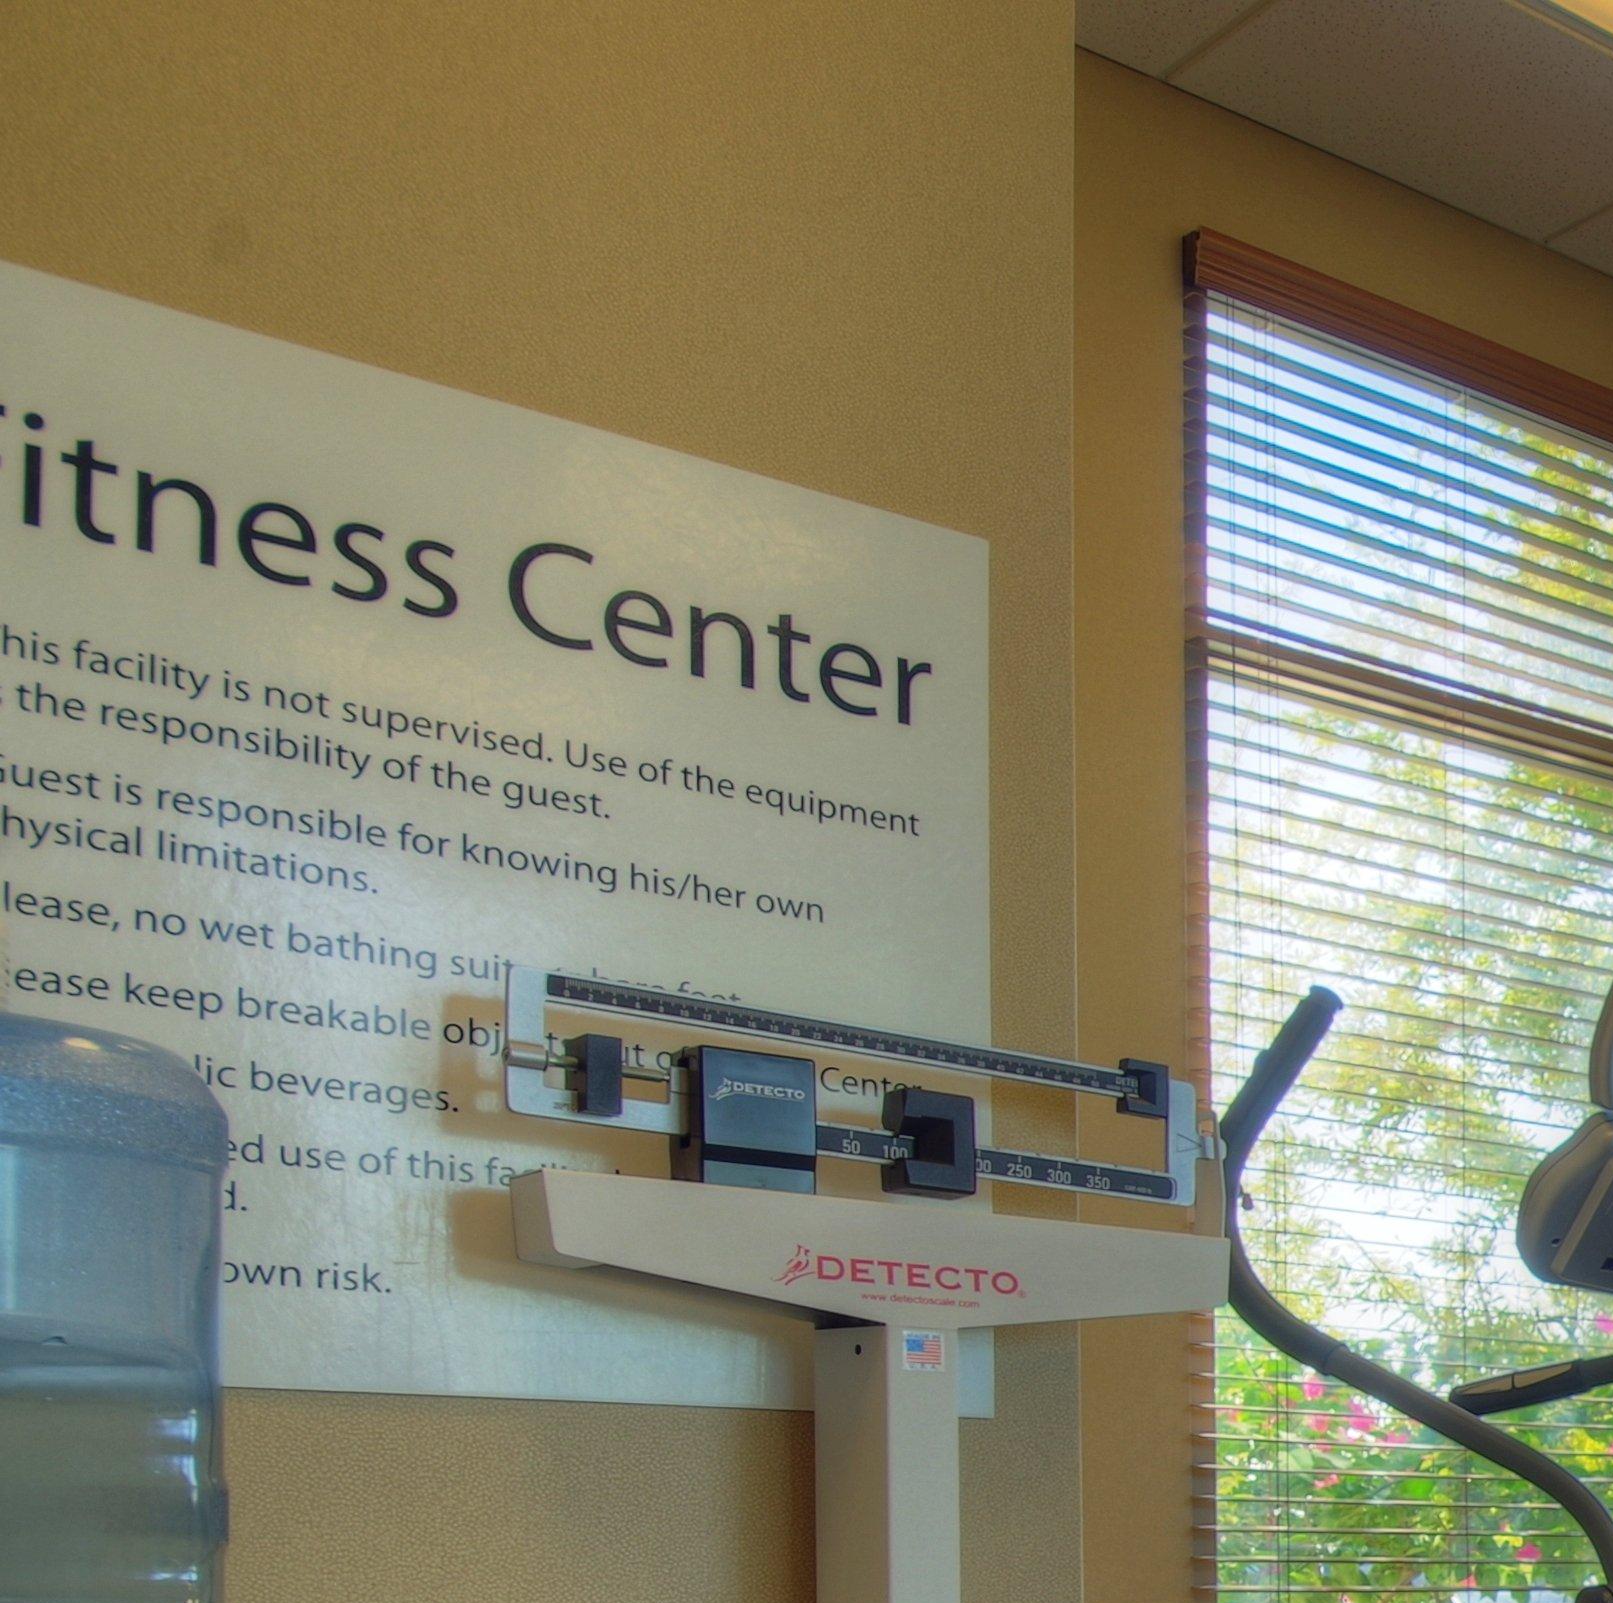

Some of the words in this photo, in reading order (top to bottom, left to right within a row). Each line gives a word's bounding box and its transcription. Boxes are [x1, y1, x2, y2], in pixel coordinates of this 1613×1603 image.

[0, 405, 458, 618] itness
[508, 542, 932, 726] Center
[16, 682, 86, 721] the
[101, 702, 371, 779] responsibility
[383, 754, 422, 783] of
[431, 760, 491, 797] the
[503, 780, 611, 820] guest.
[74, 640, 209, 699] facility
[224, 670, 250, 702] is
[265, 685, 330, 719] not
[342, 701, 552, 762] supervised.
[565, 739, 627, 777] Use
[638, 758, 673, 785] of
[681, 765, 735, 799] the
[746, 784, 920, 837] equipment
[115, 774, 142, 806] is
[157, 787, 386, 847] responsible
[398, 822, 451, 858] for
[462, 833, 617, 893] knowing
[630, 862, 746, 909] his/her
[756, 893, 825, 924] own
[157, 829, 379, 894] limitations.
[135, 907, 187, 937] no
[200, 917, 275, 950] wet
[288, 922, 437, 979] bathing
[125, 972, 224, 1020] keep
[238, 987, 430, 1041] breakable
[250, 1060, 459, 1114] beverages.
[733, 1081, 806, 1099] DETECTO
[280, 1145, 345, 1171] use
[359, 1146, 398, 1176] of
[407, 1148, 474, 1184] this
[842, 1138, 861, 1155] 50
[883, 1144, 908, 1159] 100
[1007, 1162, 1033, 1180] 250
[1047, 1168, 1072, 1186] 300
[1086, 1174, 1111, 1192] 350
[316, 1262, 392, 1294] risk.
[816, 1255, 1019, 1295] DETECTO
